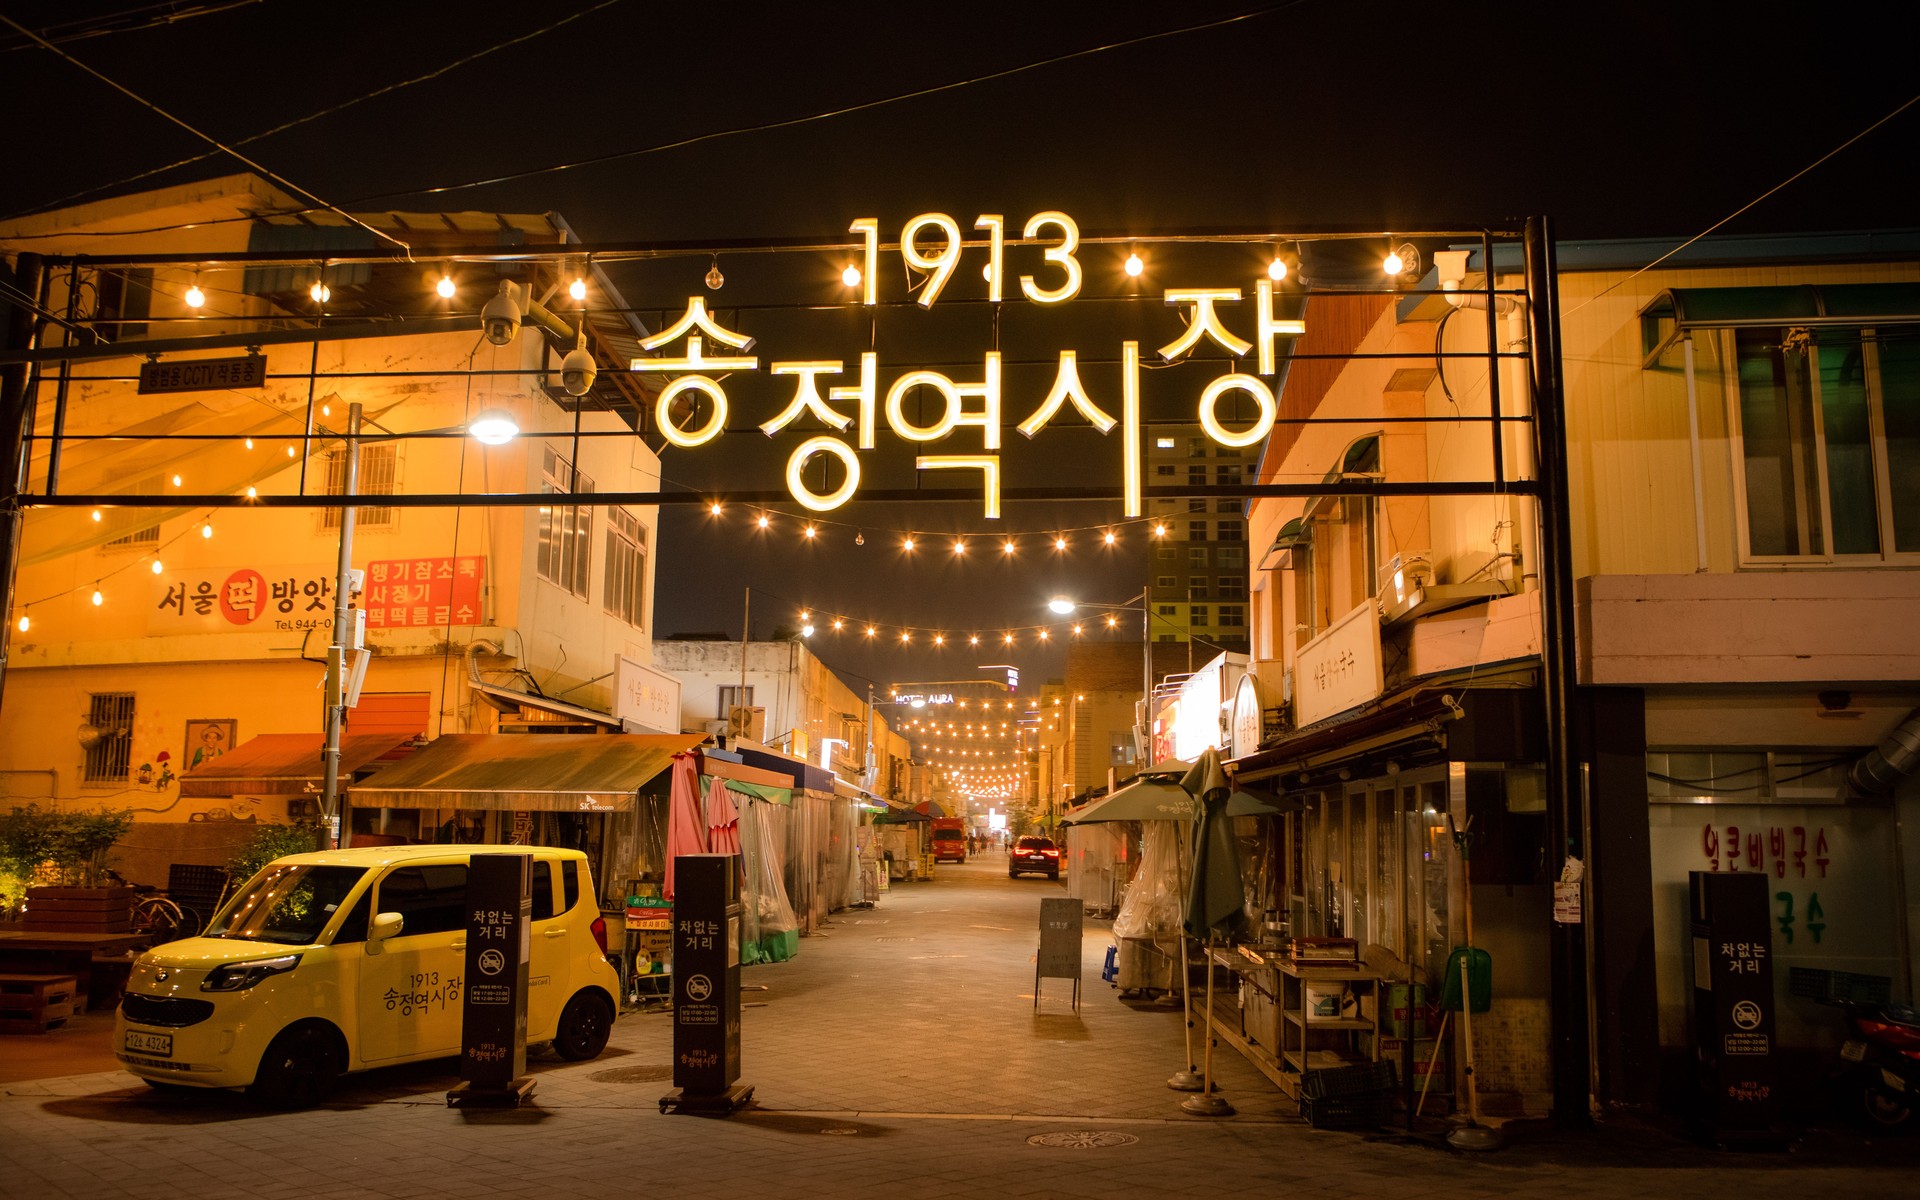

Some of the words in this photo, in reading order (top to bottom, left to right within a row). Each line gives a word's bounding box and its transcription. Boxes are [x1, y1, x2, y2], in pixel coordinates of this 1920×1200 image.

[848, 210, 1083, 310] 1913
[183, 364, 216, 386] CCTV
[630, 279, 1305, 519] 송정역시장
[295, 617, 332, 630] 944-0
[928, 694, 953, 704] AURA
[579, 802, 590, 810] SK
[473, 910, 514, 925] 차없는
[479, 926, 506, 940] 거리
[680, 921, 719, 935] 차없는
[686, 936, 713, 950] 거리
[1721, 943, 1766, 958] 차없는
[1729, 960, 1760, 974] 거리
[410, 972, 439, 989] 1913
[383, 976, 463, 1017] 송정역시장
[146, 1037, 166, 1050] 4324
[469, 1047, 507, 1062] 송정역시장
[681, 1054, 718, 1069] 송정역시장
[1728, 1086, 1770, 1101] 송정역시장
